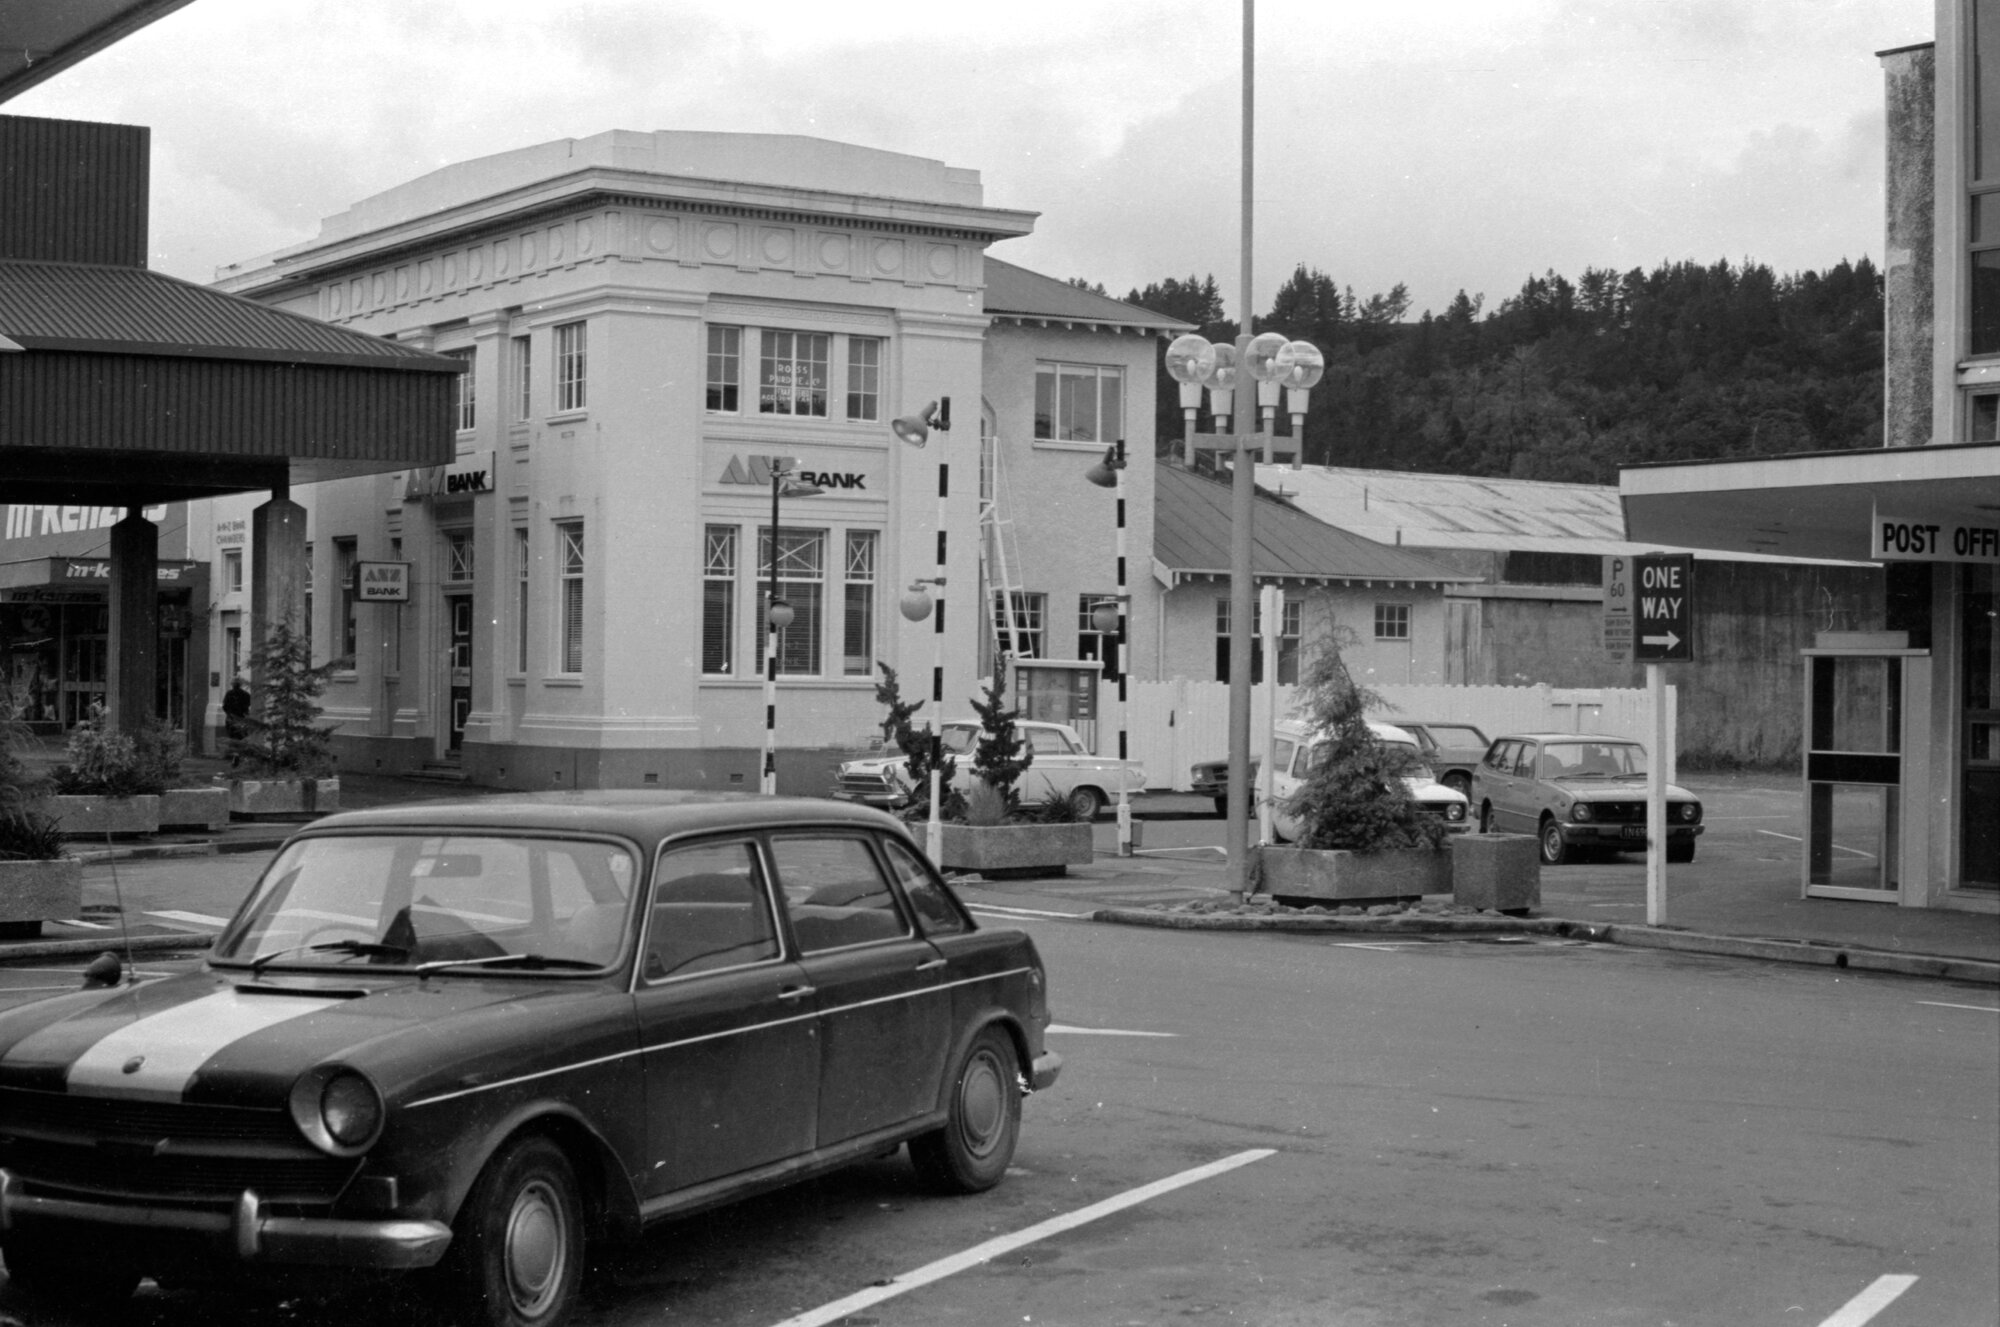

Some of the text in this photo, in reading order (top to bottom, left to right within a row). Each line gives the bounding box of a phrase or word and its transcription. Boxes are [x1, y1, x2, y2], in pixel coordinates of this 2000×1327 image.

[769, 374, 803, 385] PURDE
[447, 470, 487, 493] BANK
[800, 471, 866, 489] BANK
[1883, 523, 1940, 554] POST
[364, 568, 401, 582] ANZ
[1613, 559, 1624, 580] P
[1643, 566, 1681, 589] ONE
[367, 587, 401, 596] BANK
[1610, 583, 1625, 597] 60
[1641, 597, 1683, 619] WAY
